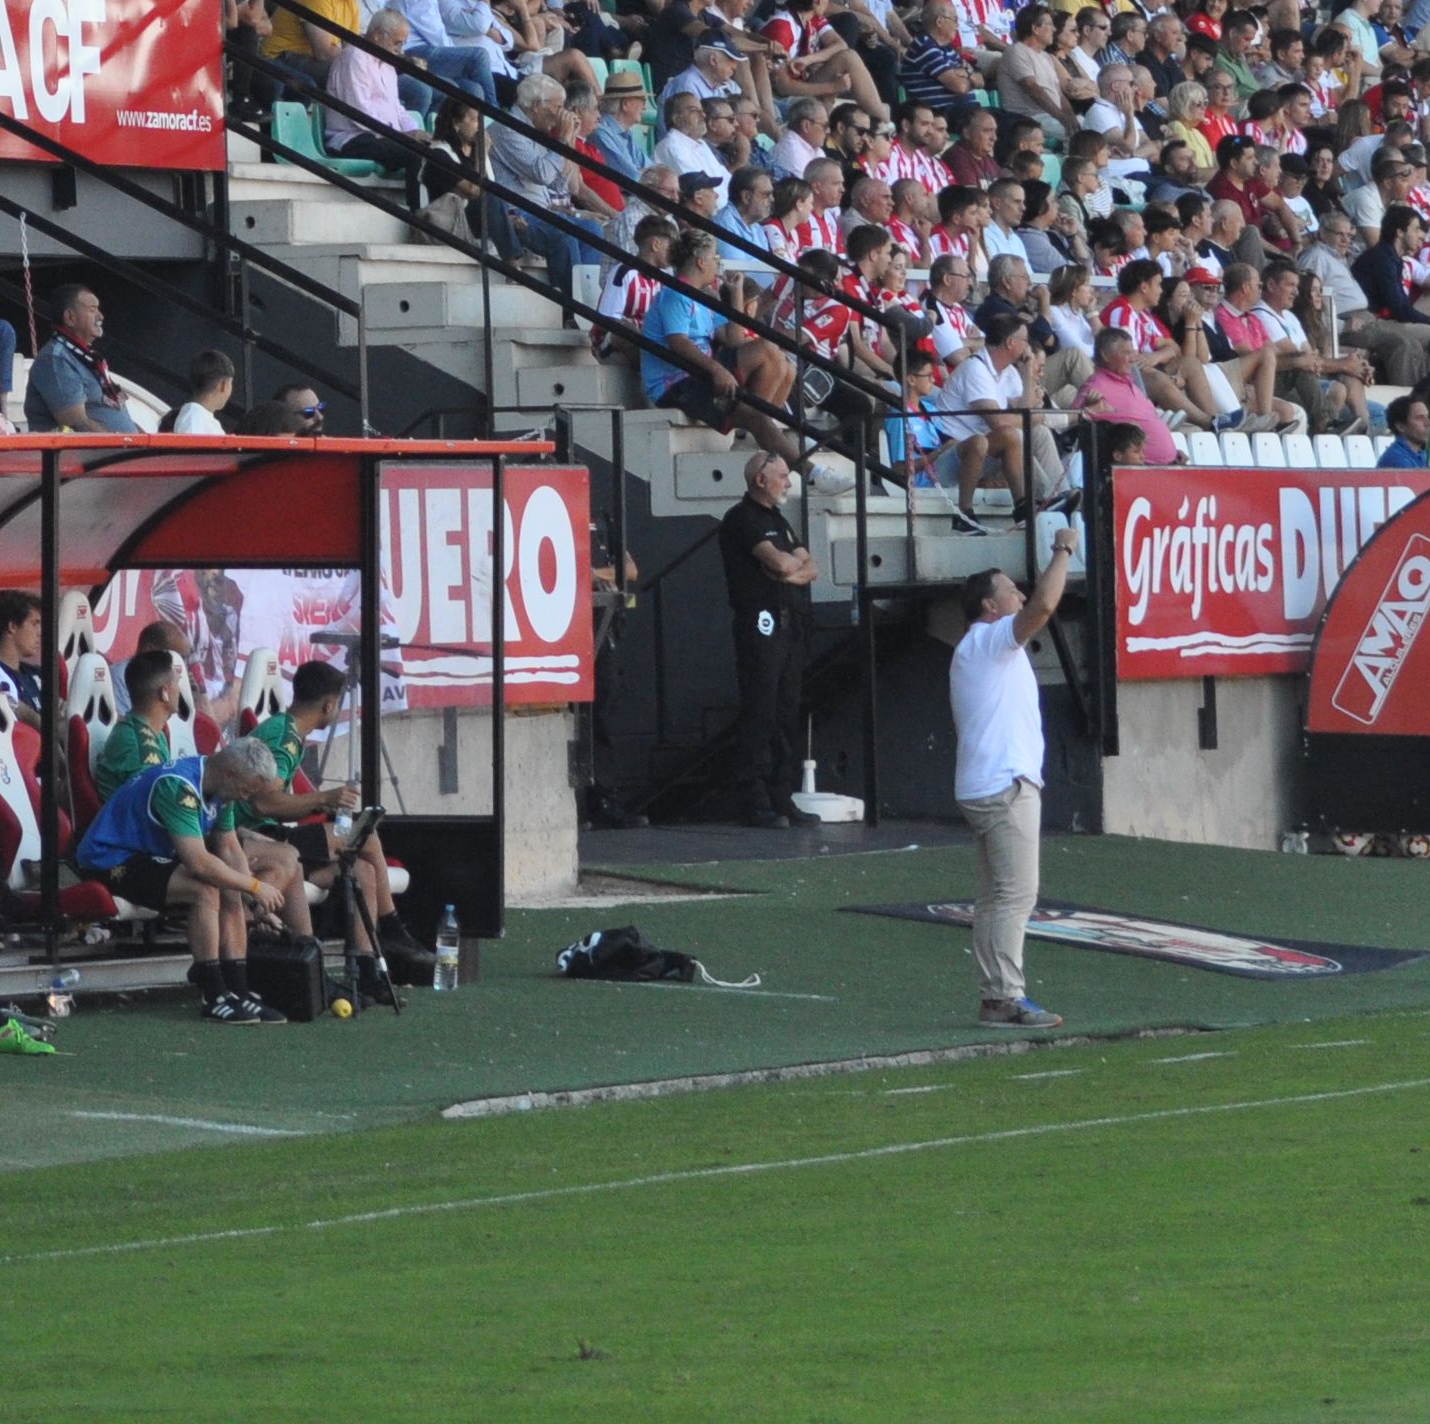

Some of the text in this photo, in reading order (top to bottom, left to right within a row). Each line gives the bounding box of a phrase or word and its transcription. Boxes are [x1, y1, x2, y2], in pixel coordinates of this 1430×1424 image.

[116, 108, 212, 133] www.zamoracf.es
[380, 485, 577, 643] UERO
[1123, 494, 1274, 626] Gráficas
